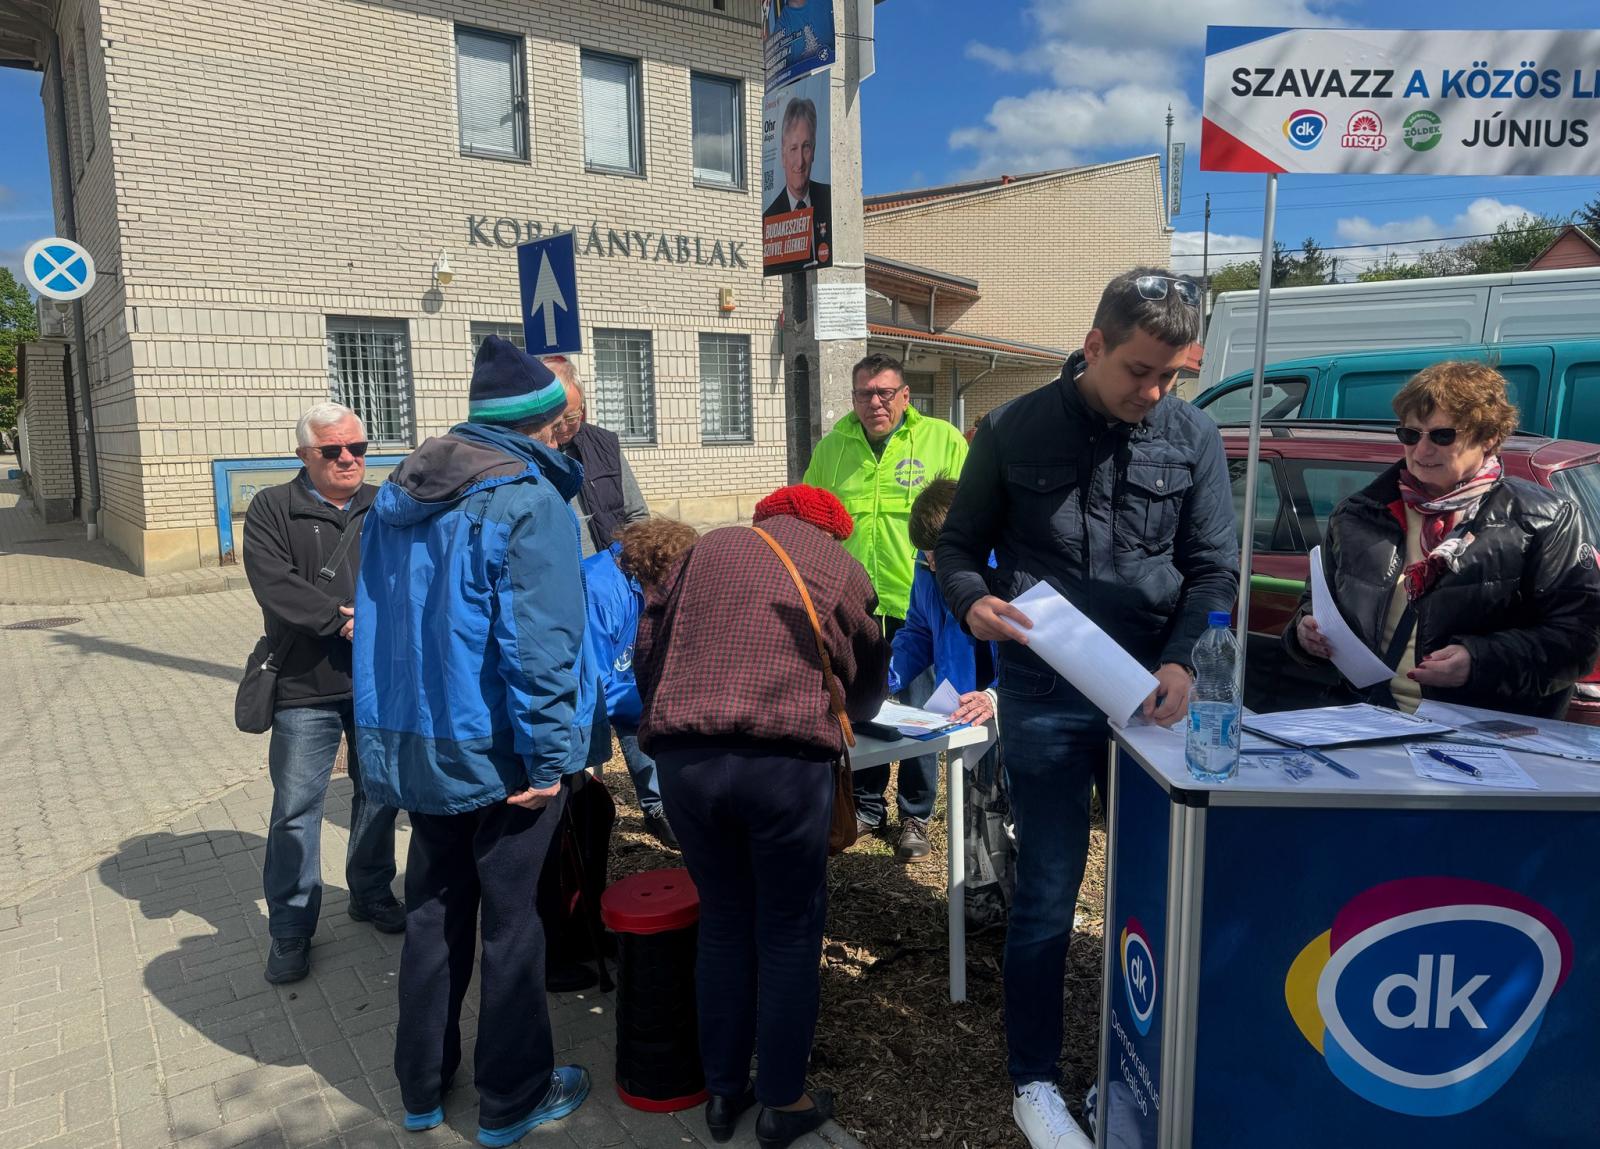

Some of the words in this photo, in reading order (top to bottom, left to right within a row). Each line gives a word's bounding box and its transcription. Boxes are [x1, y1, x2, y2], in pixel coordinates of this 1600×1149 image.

[1231, 67, 1395, 98] SZAVAZZ
[1402, 69, 1430, 98] A
[1441, 60, 1562, 98] KÖZÖS
[764, 120, 776, 133] Ohr
[1295, 121, 1315, 136] dk
[1342, 134, 1386, 150] mszp
[1404, 126, 1441, 137] ZÖLDEK
[1461, 110, 1589, 147] JÚNIUS
[765, 213, 811, 239] BUDAKESZIÉRT
[1131, 956, 1147, 1002] dk
[1373, 954, 1491, 1029] dk
[1111, 1009, 1160, 1110] Demokratikus
[1120, 1053, 1148, 1117] Koalíció
